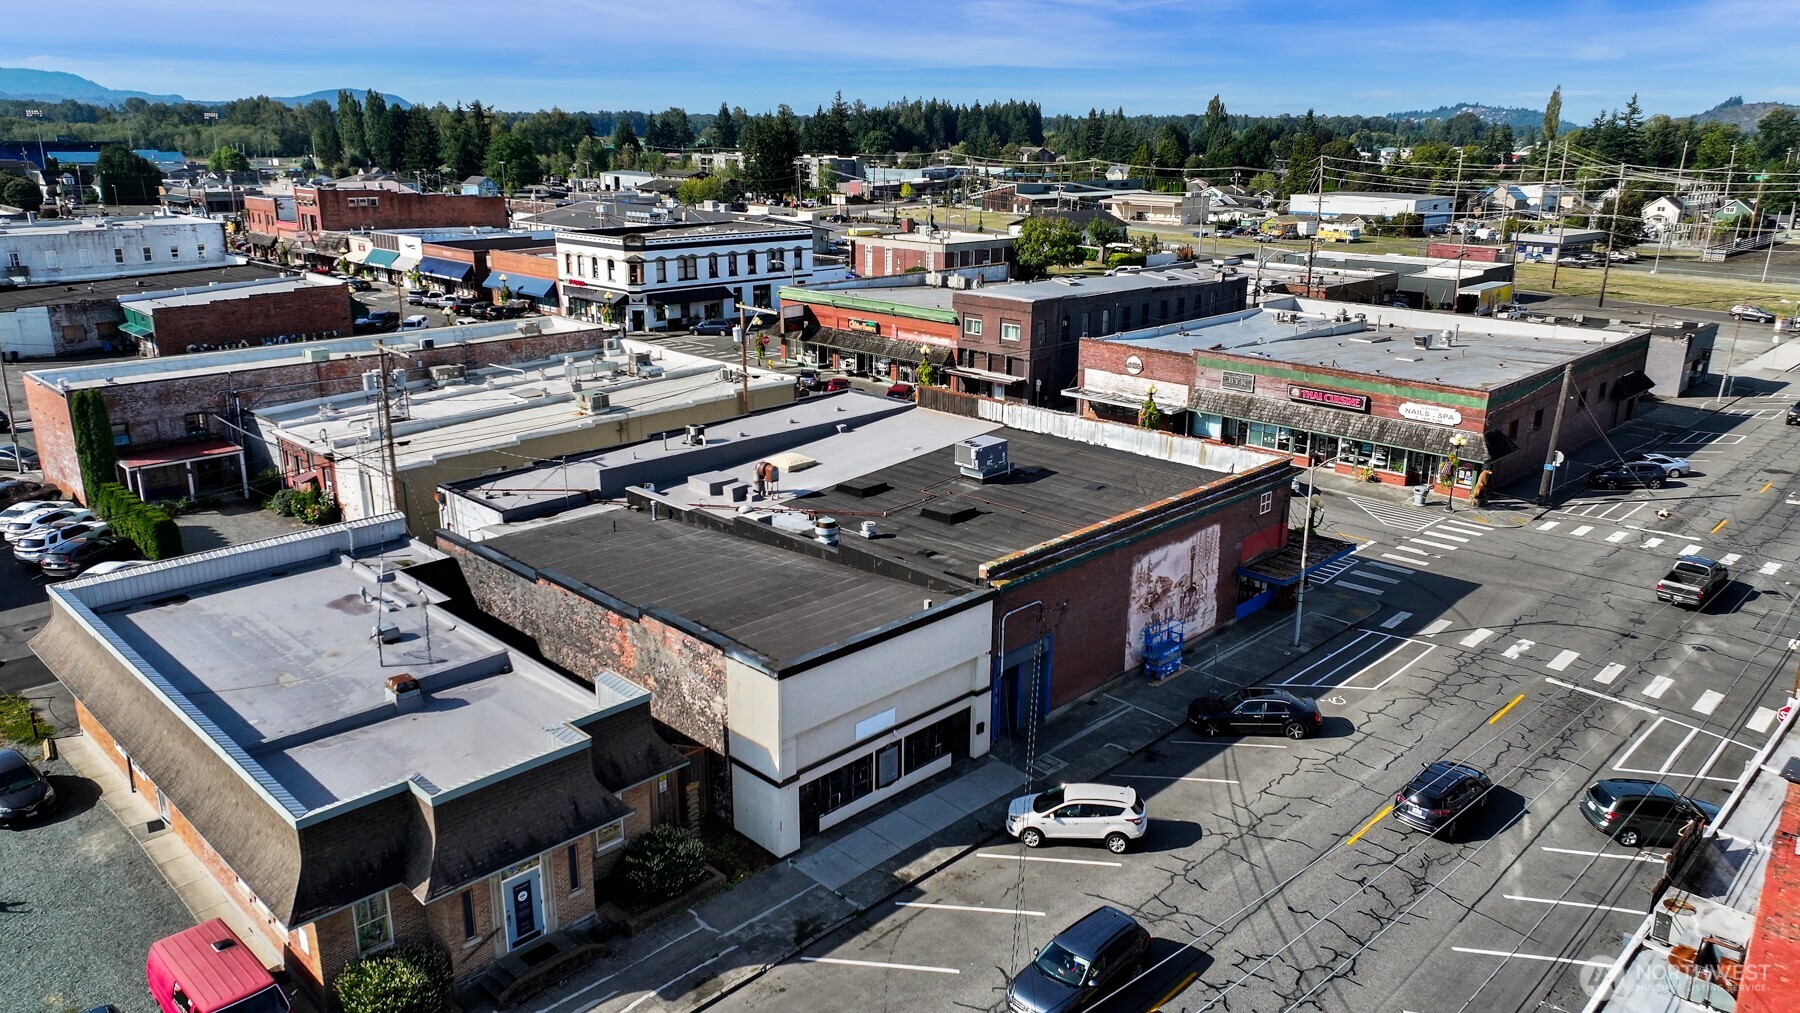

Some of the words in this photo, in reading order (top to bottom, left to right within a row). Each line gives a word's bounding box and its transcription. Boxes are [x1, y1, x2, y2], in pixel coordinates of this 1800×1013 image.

[1301, 389, 1323, 401] THAI
[1323, 393, 1361, 407] CUISINE
[1404, 407, 1430, 417] NAILS
[1437, 412, 1454, 421] SPA
